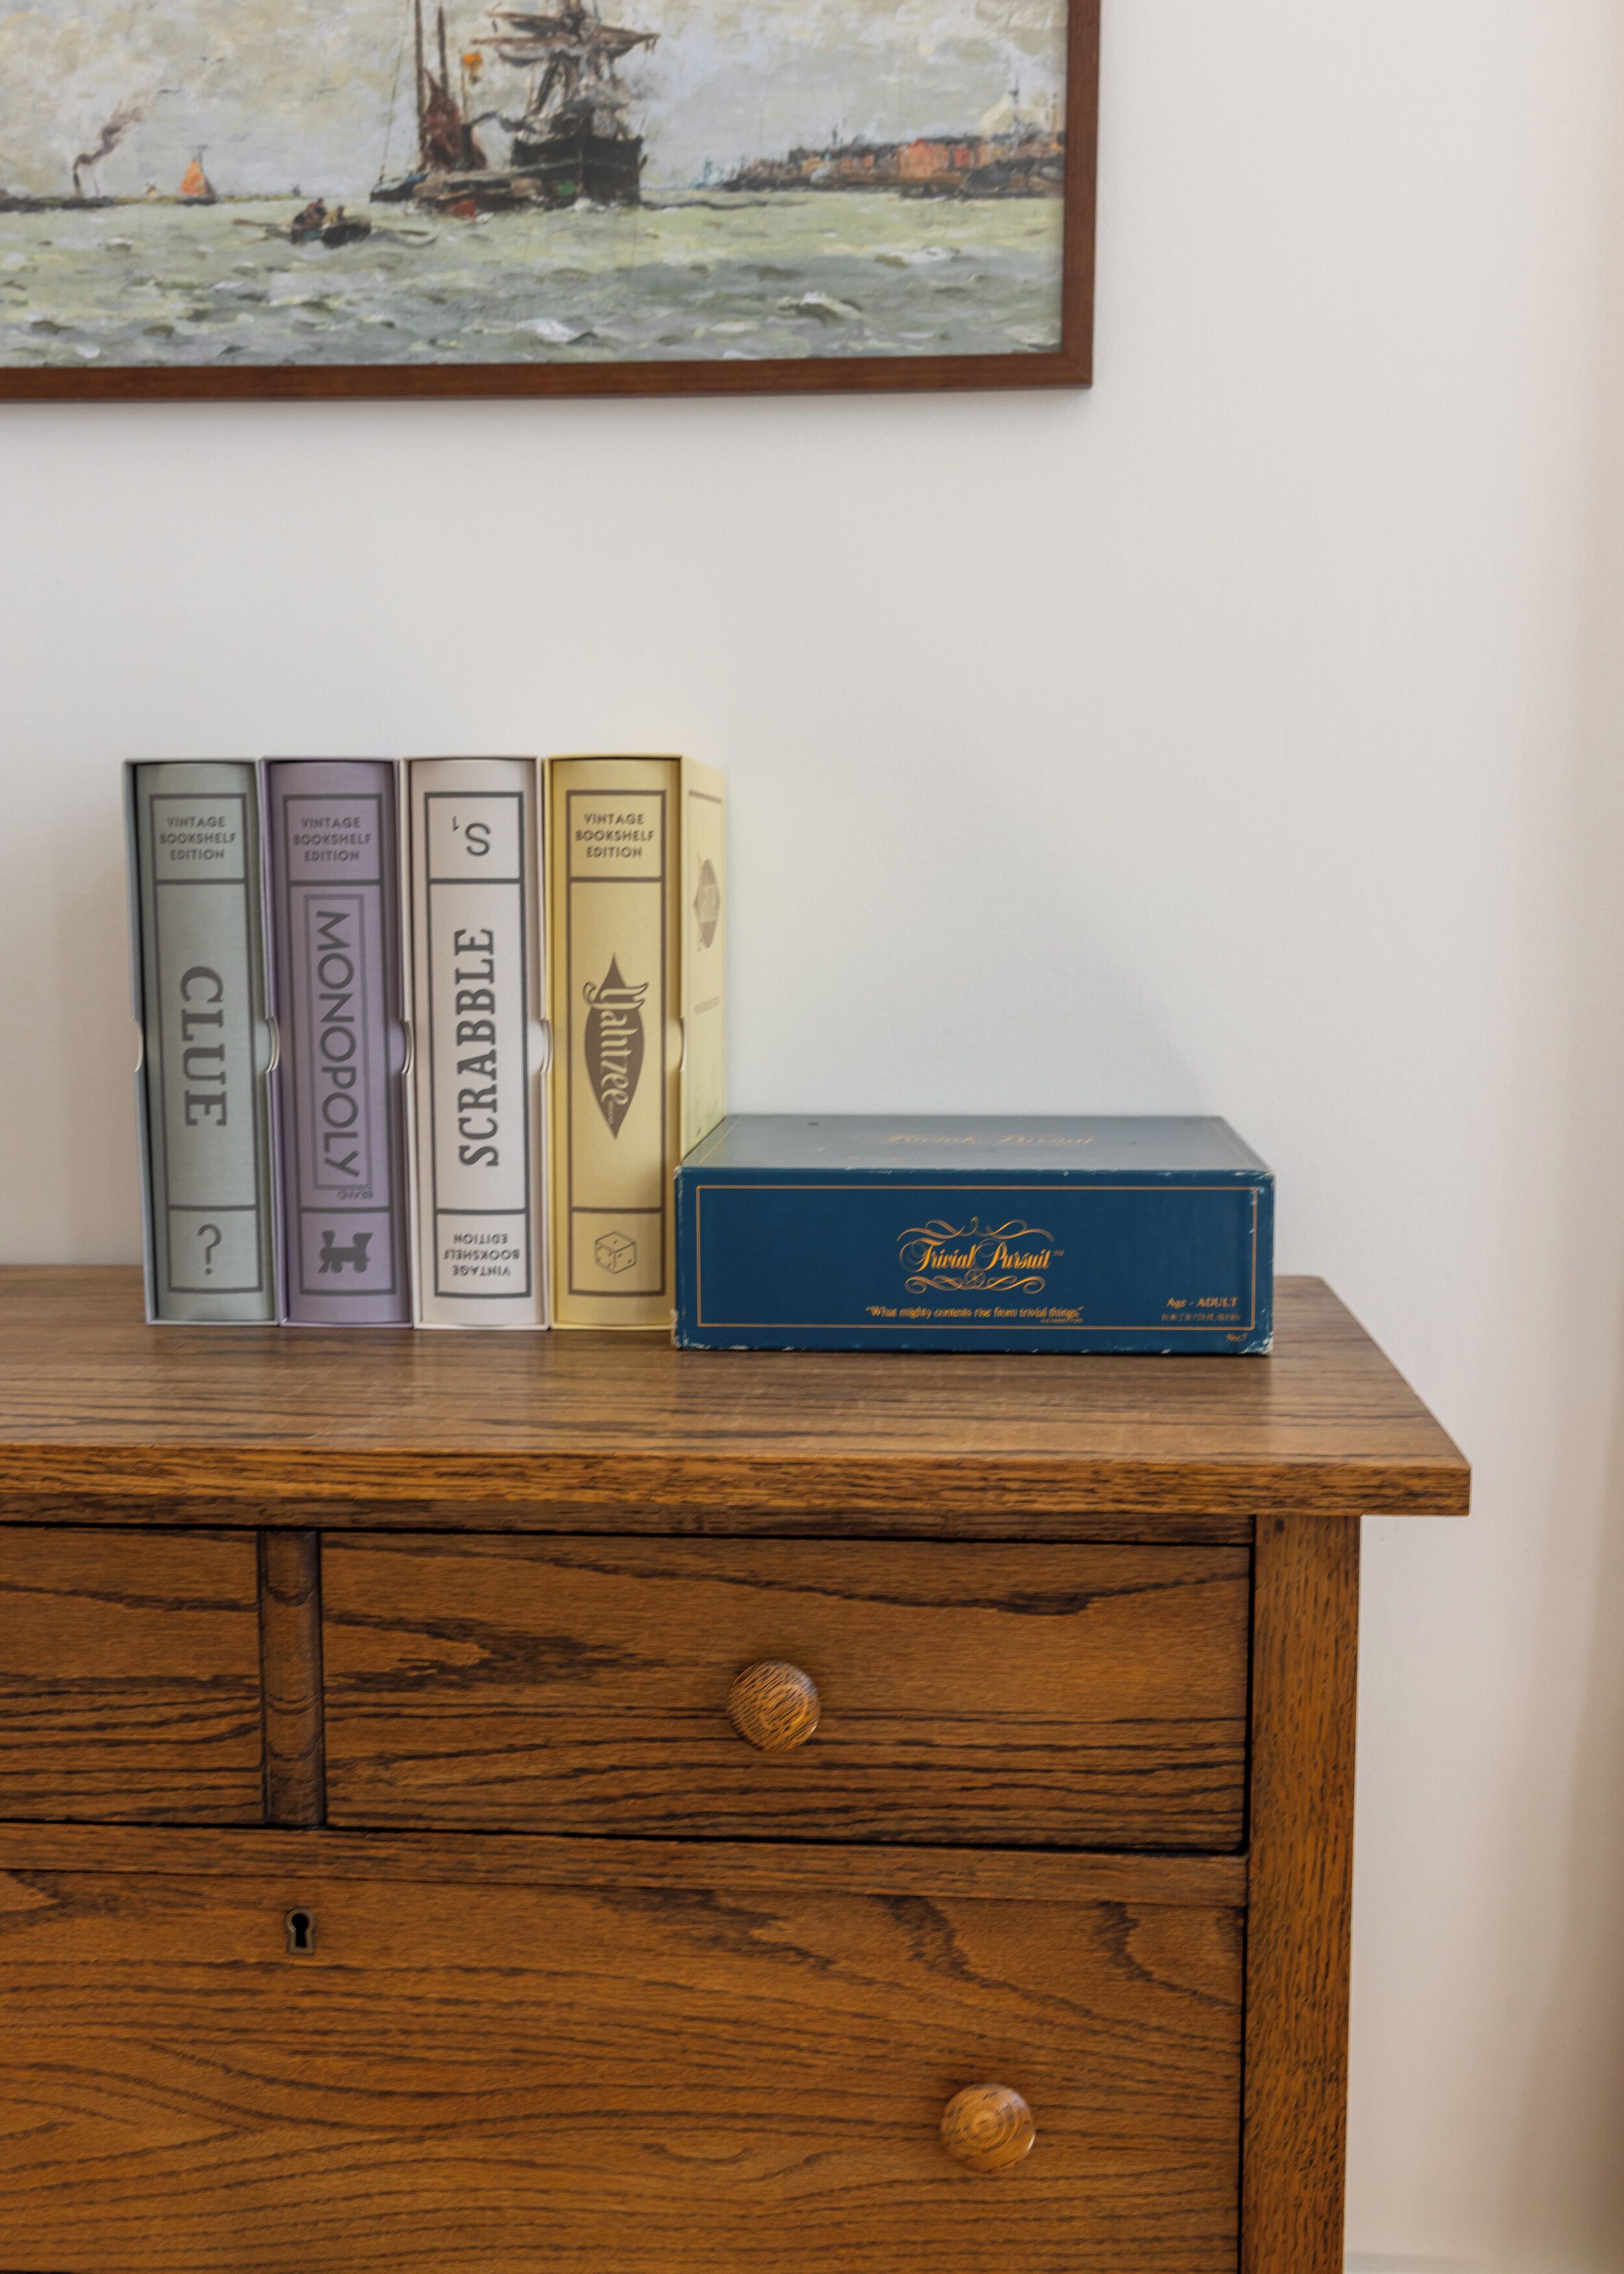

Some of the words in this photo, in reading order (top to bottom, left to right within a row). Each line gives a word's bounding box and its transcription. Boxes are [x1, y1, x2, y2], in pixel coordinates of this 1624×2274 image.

[166, 816, 226, 828] VINTAGE
[301, 817, 361, 828] VINTAGE
[584, 813, 645, 825] VINTAGE
[160, 832, 236, 845] BOOKSHELF
[293, 833, 371, 845] BOOKSHELF
[576, 830, 654, 841] BOOKSHELF
[170, 849, 225, 861] EDITION
[304, 850, 360, 862] EDITION
[586, 847, 642, 858] EDITION
[180, 965, 228, 1127] CLUE
[316, 910, 359, 1177] MONOPOLY
[453, 928, 500, 1167] SCRABBLE
[583, 982, 648, 1105] Yahtzee
[453, 1233, 507, 1244] EDITION
[444, 1248, 520, 1260] BOOKSHELF
[899, 1237, 977, 1272] Trivial
[974, 1236, 1052, 1271] Pursuit
[451, 1265, 510, 1277] VINTAGE
[1167, 1297, 1187, 1309] Age
[1196, 1297, 1239, 1307] ADULT
[900, 1306, 932, 1319] mighty
[933, 1307, 972, 1318] contests
[974, 1307, 991, 1318] rise
[994, 1306, 1017, 1318] from
[1020, 1306, 1047, 1318] trivial
